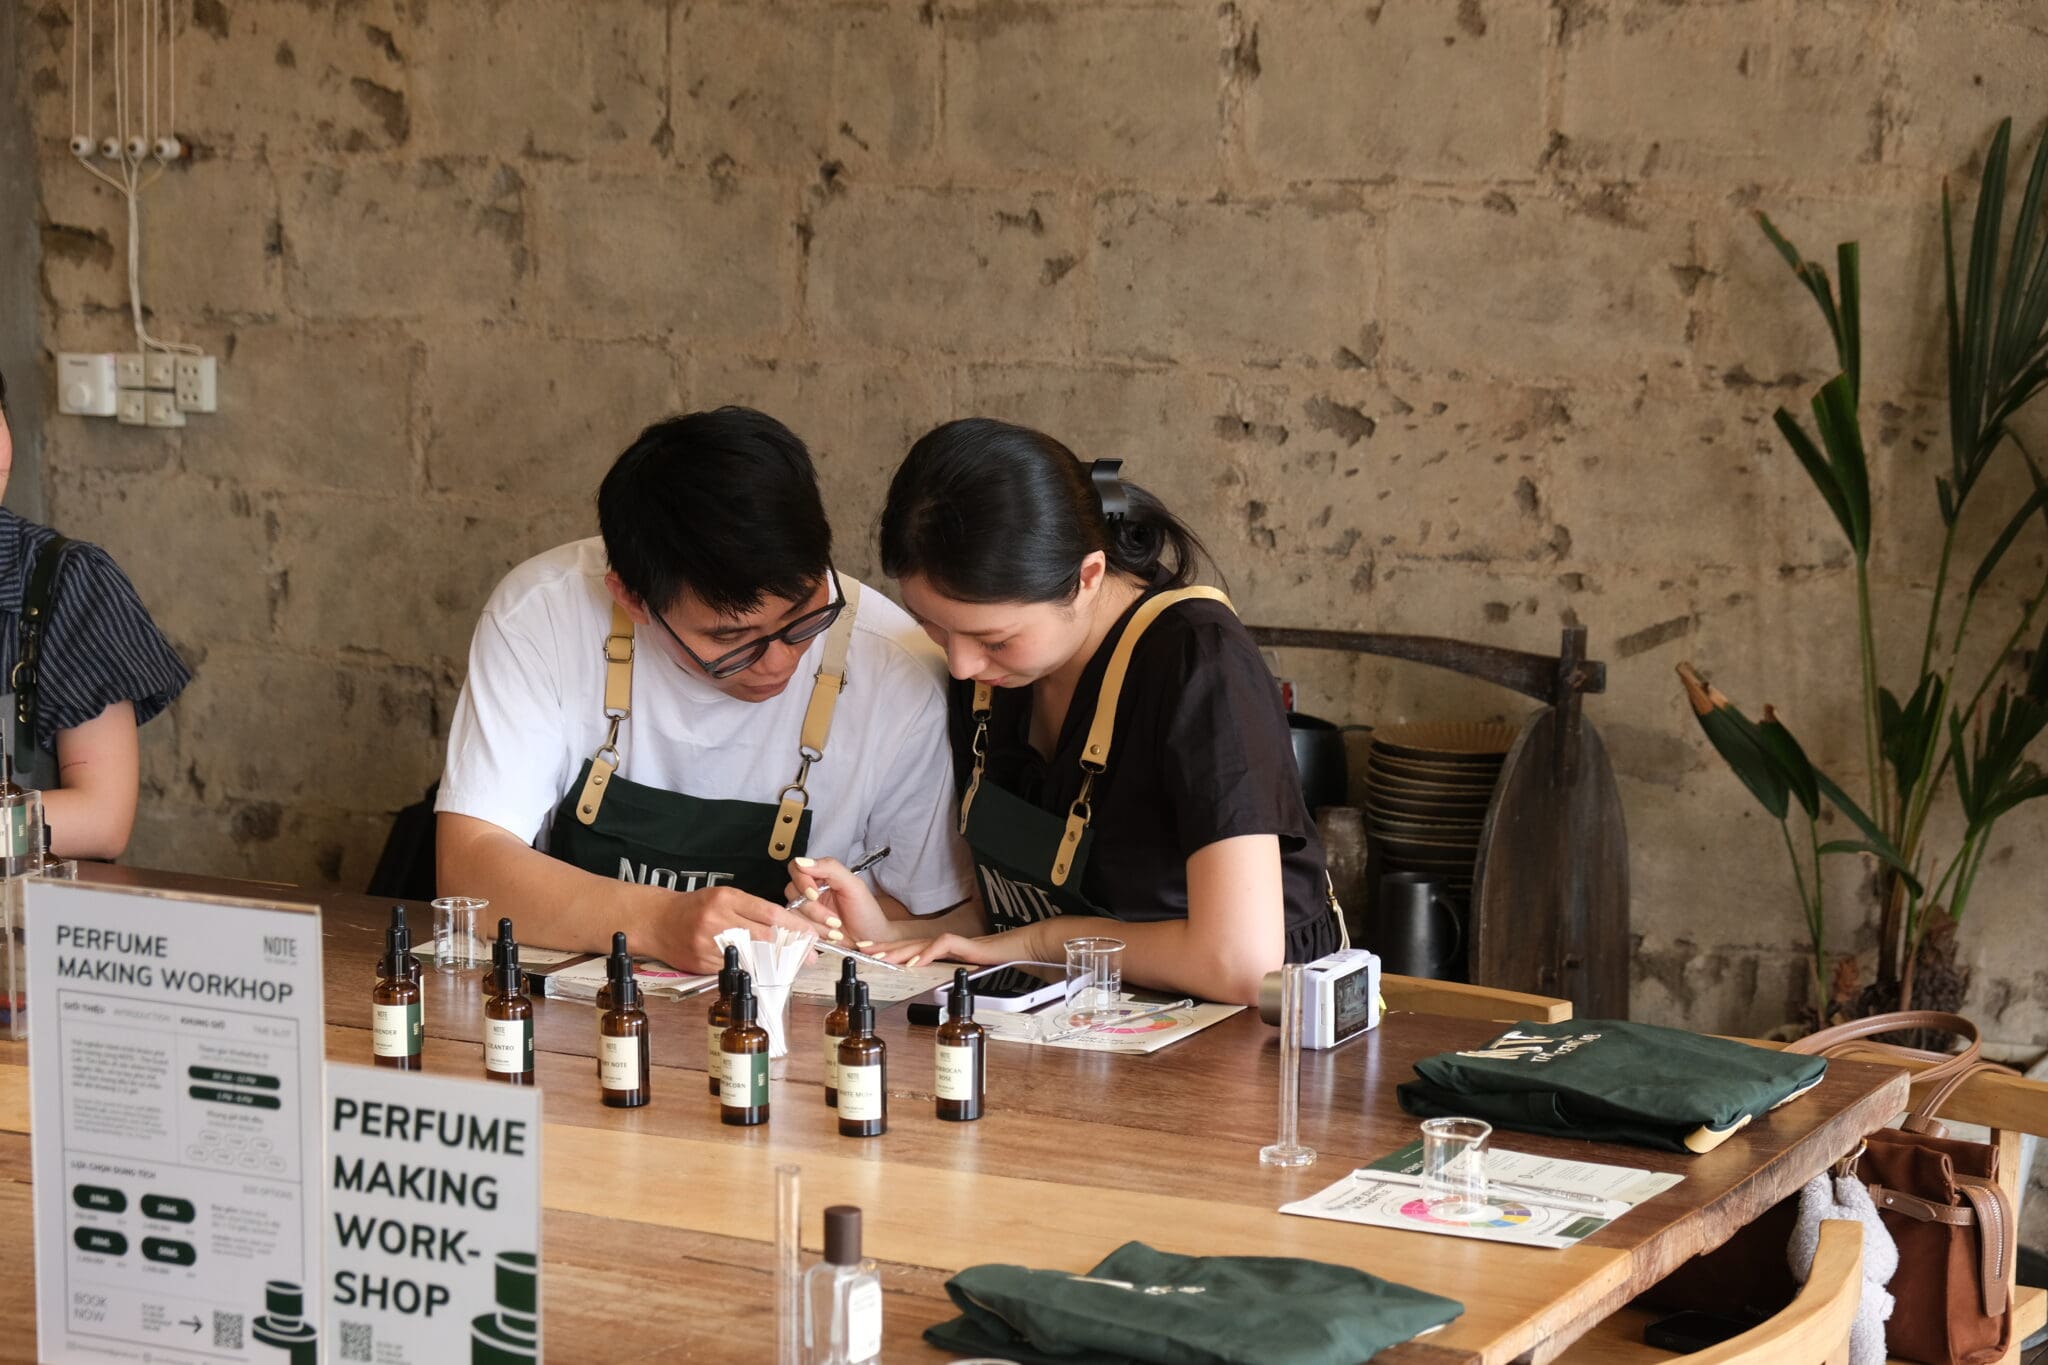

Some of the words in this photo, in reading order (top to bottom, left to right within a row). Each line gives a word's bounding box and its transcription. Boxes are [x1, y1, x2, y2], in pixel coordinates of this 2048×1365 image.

[56, 925, 169, 958] PERFUME
[263, 935, 298, 958] NOTE
[57, 956, 153, 987] MAKING
[160, 967, 294, 1004] WORKHOP
[333, 1097, 526, 1157] PERFUME
[333, 1154, 498, 1211] MAKING
[333, 1211, 481, 1266] WORK-
[73, 1292, 108, 1307] BOOK
[74, 1307, 105, 1322] NOW
[333, 1270, 450, 1318] SHOP
